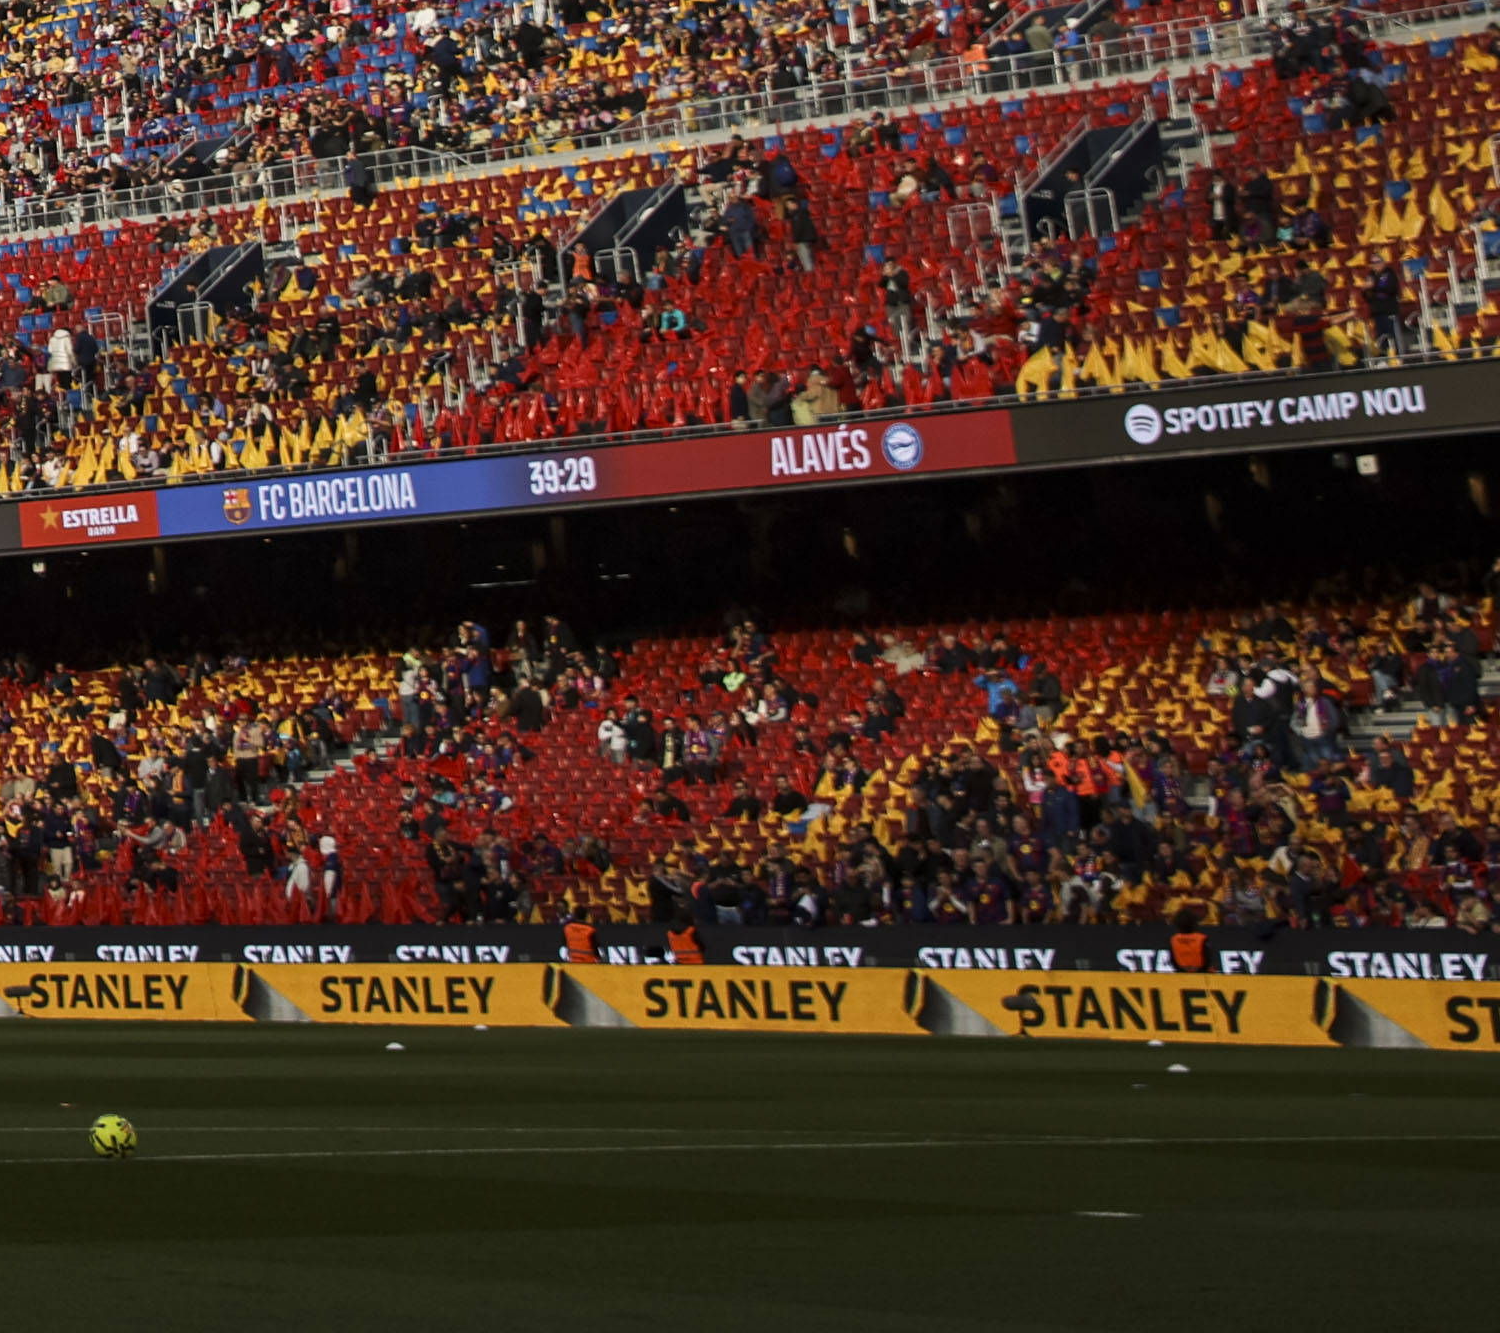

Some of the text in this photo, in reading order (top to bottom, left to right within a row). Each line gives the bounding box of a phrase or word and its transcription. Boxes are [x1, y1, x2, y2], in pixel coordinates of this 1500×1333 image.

[1164, 385, 1425, 434] SPOTIFY CAMP NOU
[770, 423, 872, 476] ALAVÉS
[527, 455, 597, 495] 39:29
[258, 472, 417, 520] FC BARCELONA
[62, 504, 139, 529] ESTRELLA
[1117, 949, 1263, 975] STAEY
[29, 974, 189, 1010] STANLEY
[320, 976, 494, 1014] STANLEY
[644, 978, 848, 1022] STANLEY
